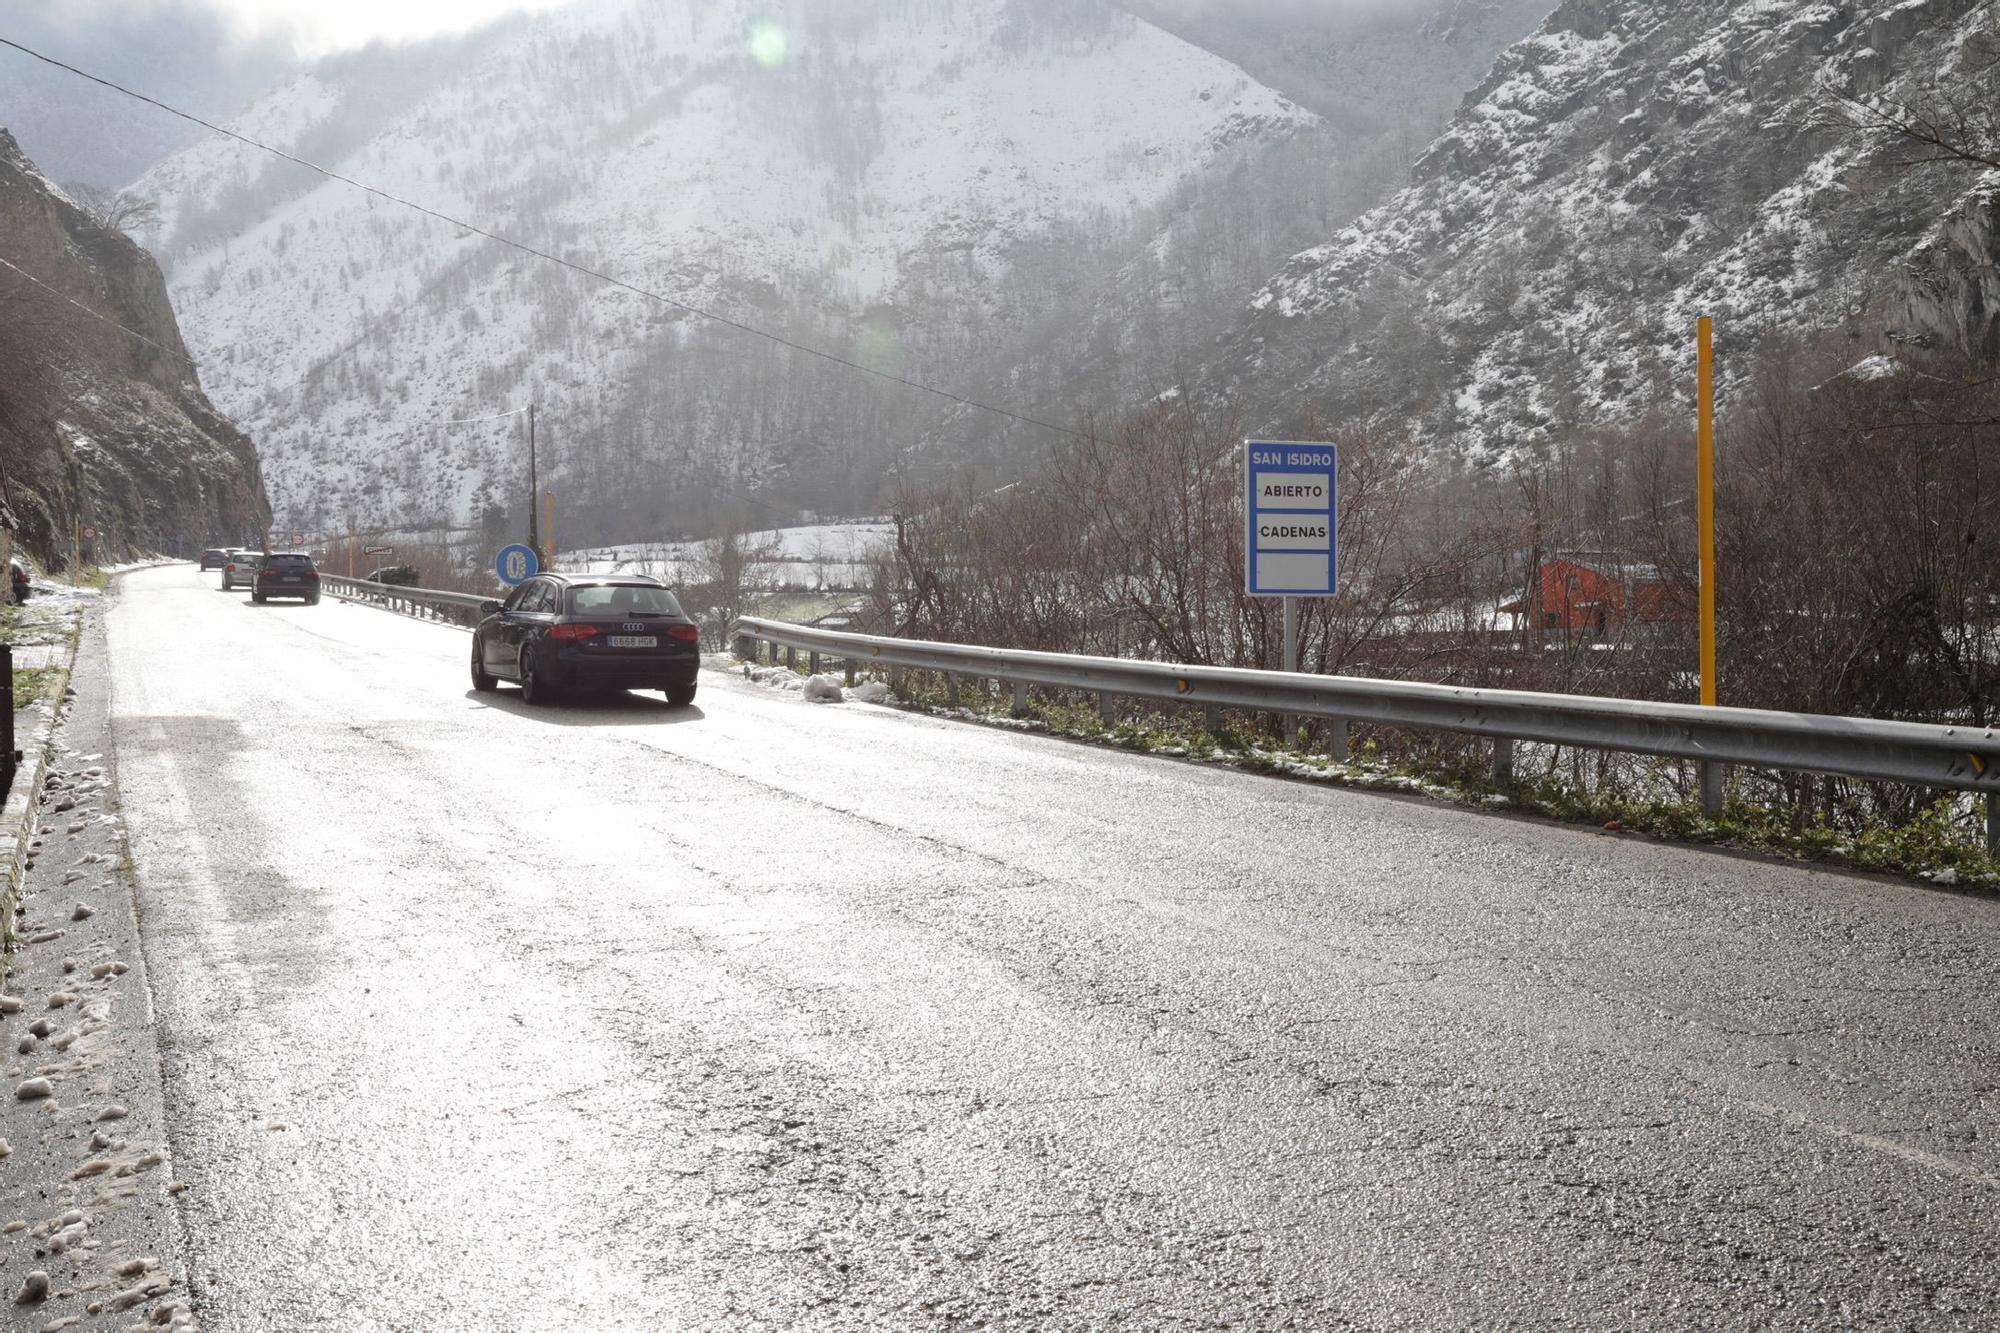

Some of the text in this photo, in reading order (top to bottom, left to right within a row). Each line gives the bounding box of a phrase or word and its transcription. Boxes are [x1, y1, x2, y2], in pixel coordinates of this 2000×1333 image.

[1253, 452, 1331, 465] SAN ISIDRO
[1264, 486, 1322, 497] ABIERTO
[1261, 526, 1326, 538] CADENAS
